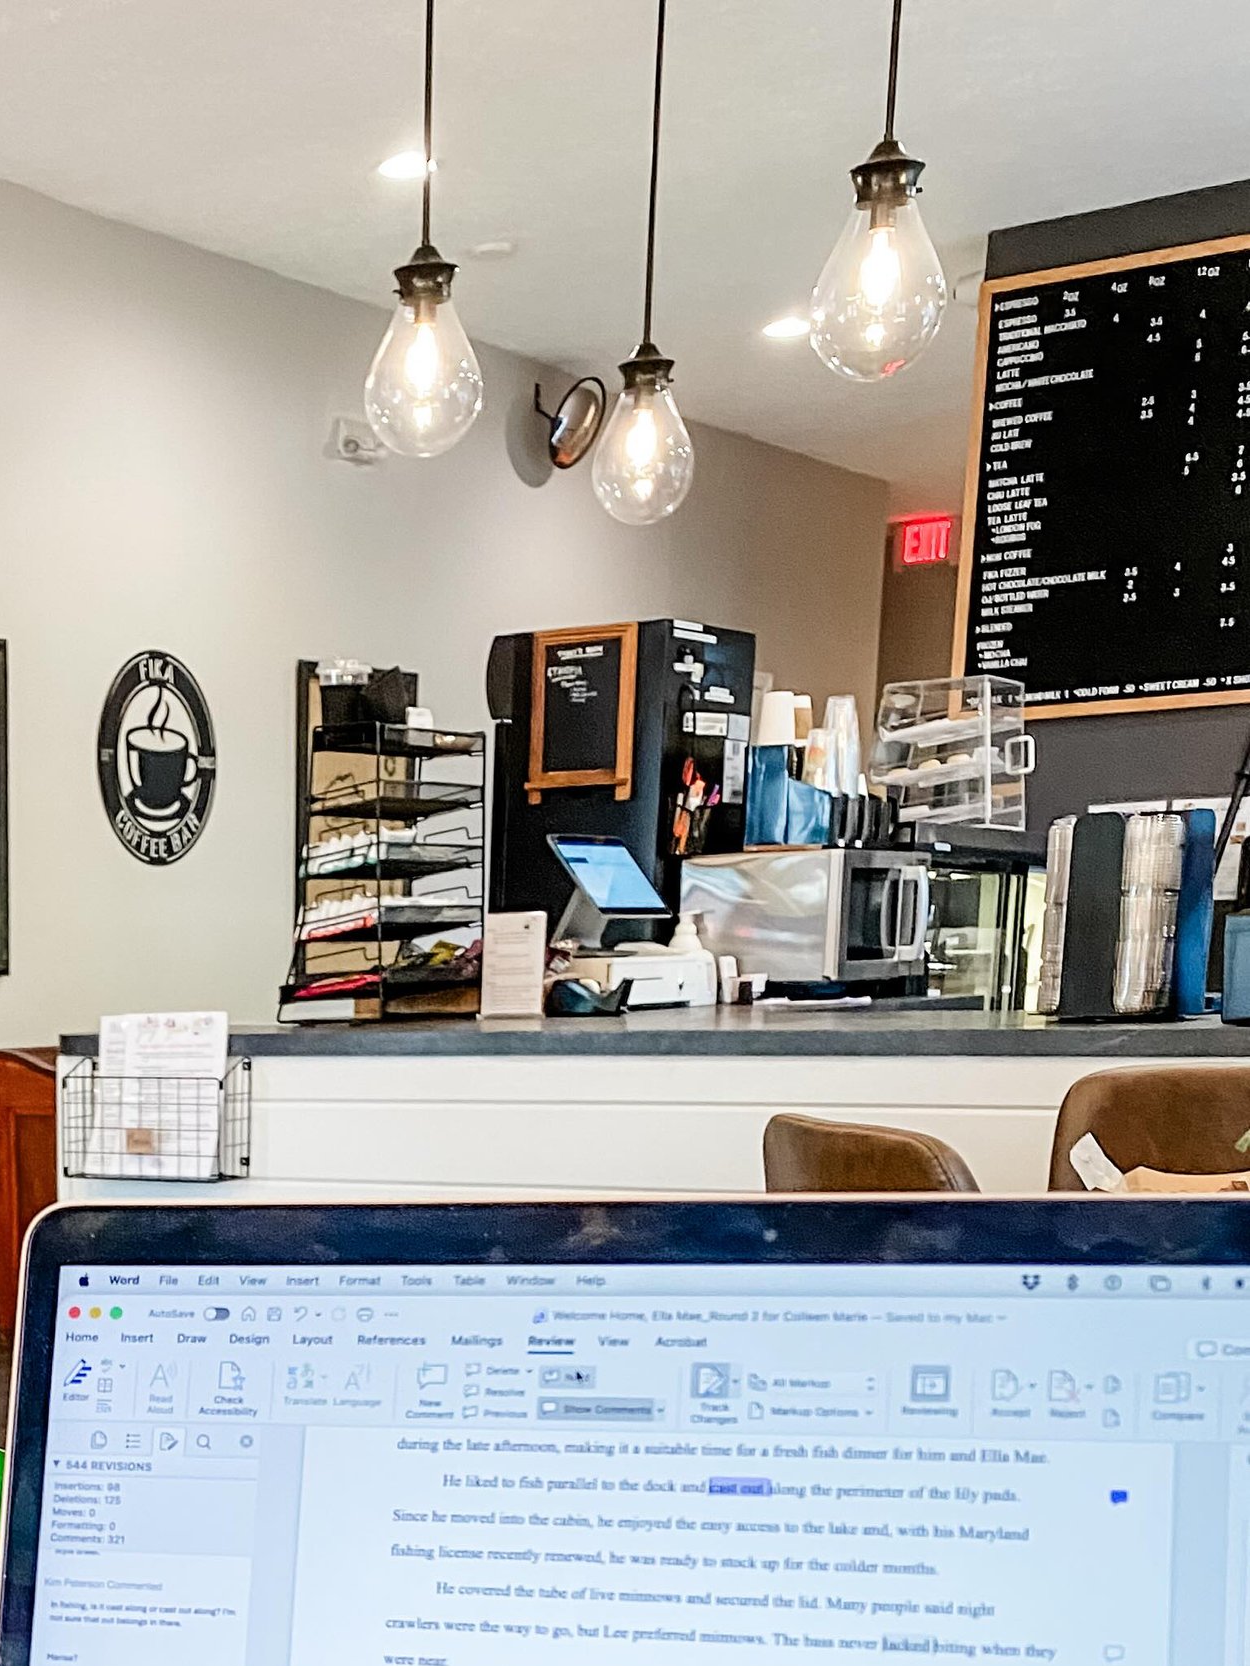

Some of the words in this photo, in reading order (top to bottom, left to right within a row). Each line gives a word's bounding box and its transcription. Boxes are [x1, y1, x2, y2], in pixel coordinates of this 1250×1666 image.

[904, 521, 951, 562] EXIT
[138, 658, 175, 685] FIKA
[115, 809, 168, 858] COFFEE
[169, 812, 200, 854] BAR
[109, 1275, 140, 1286] Word
[159, 1275, 179, 1286] File
[198, 1275, 220, 1286] Edit
[240, 1275, 267, 1286] View
[287, 1275, 319, 1287] Insert
[339, 1275, 381, 1287] Format
[402, 1275, 432, 1287] Tools
[454, 1275, 486, 1287] Table
[506, 1275, 556, 1287] Window
[577, 1275, 606, 1288] Help
[148, 1308, 195, 1320] AutoSave
[66, 1332, 99, 1343] Home
[121, 1332, 154, 1344] Insert
[177, 1333, 206, 1344] Draw
[229, 1334, 270, 1347] Design
[293, 1334, 333, 1347] Layout
[358, 1334, 426, 1346] References
[451, 1335, 503, 1348] Mailings
[528, 1335, 575, 1347] Review
[598, 1336, 629, 1347] View
[655, 1336, 707, 1348] Acrobat
[214, 1395, 244, 1405] Check
[199, 1406, 258, 1418] Accessibility
[397, 1438, 438, 1453] during
[443, 1438, 462, 1451] the
[467, 1438, 490, 1451] late
[66, 1460, 87, 1470] 544
[91, 1460, 152, 1472] REVISIONS
[54, 1481, 103, 1492] Insertions:
[107, 1482, 120, 1492] 98
[54, 1495, 101, 1505] Deletions:
[52, 1507, 86, 1517] Moves:
[89, 1508, 96, 1517] 0
[51, 1520, 104, 1532] Formatting:
[110, 1521, 116, 1531] 0
[50, 1533, 104, 1544] Comments:
[108, 1535, 125, 1545] 321
